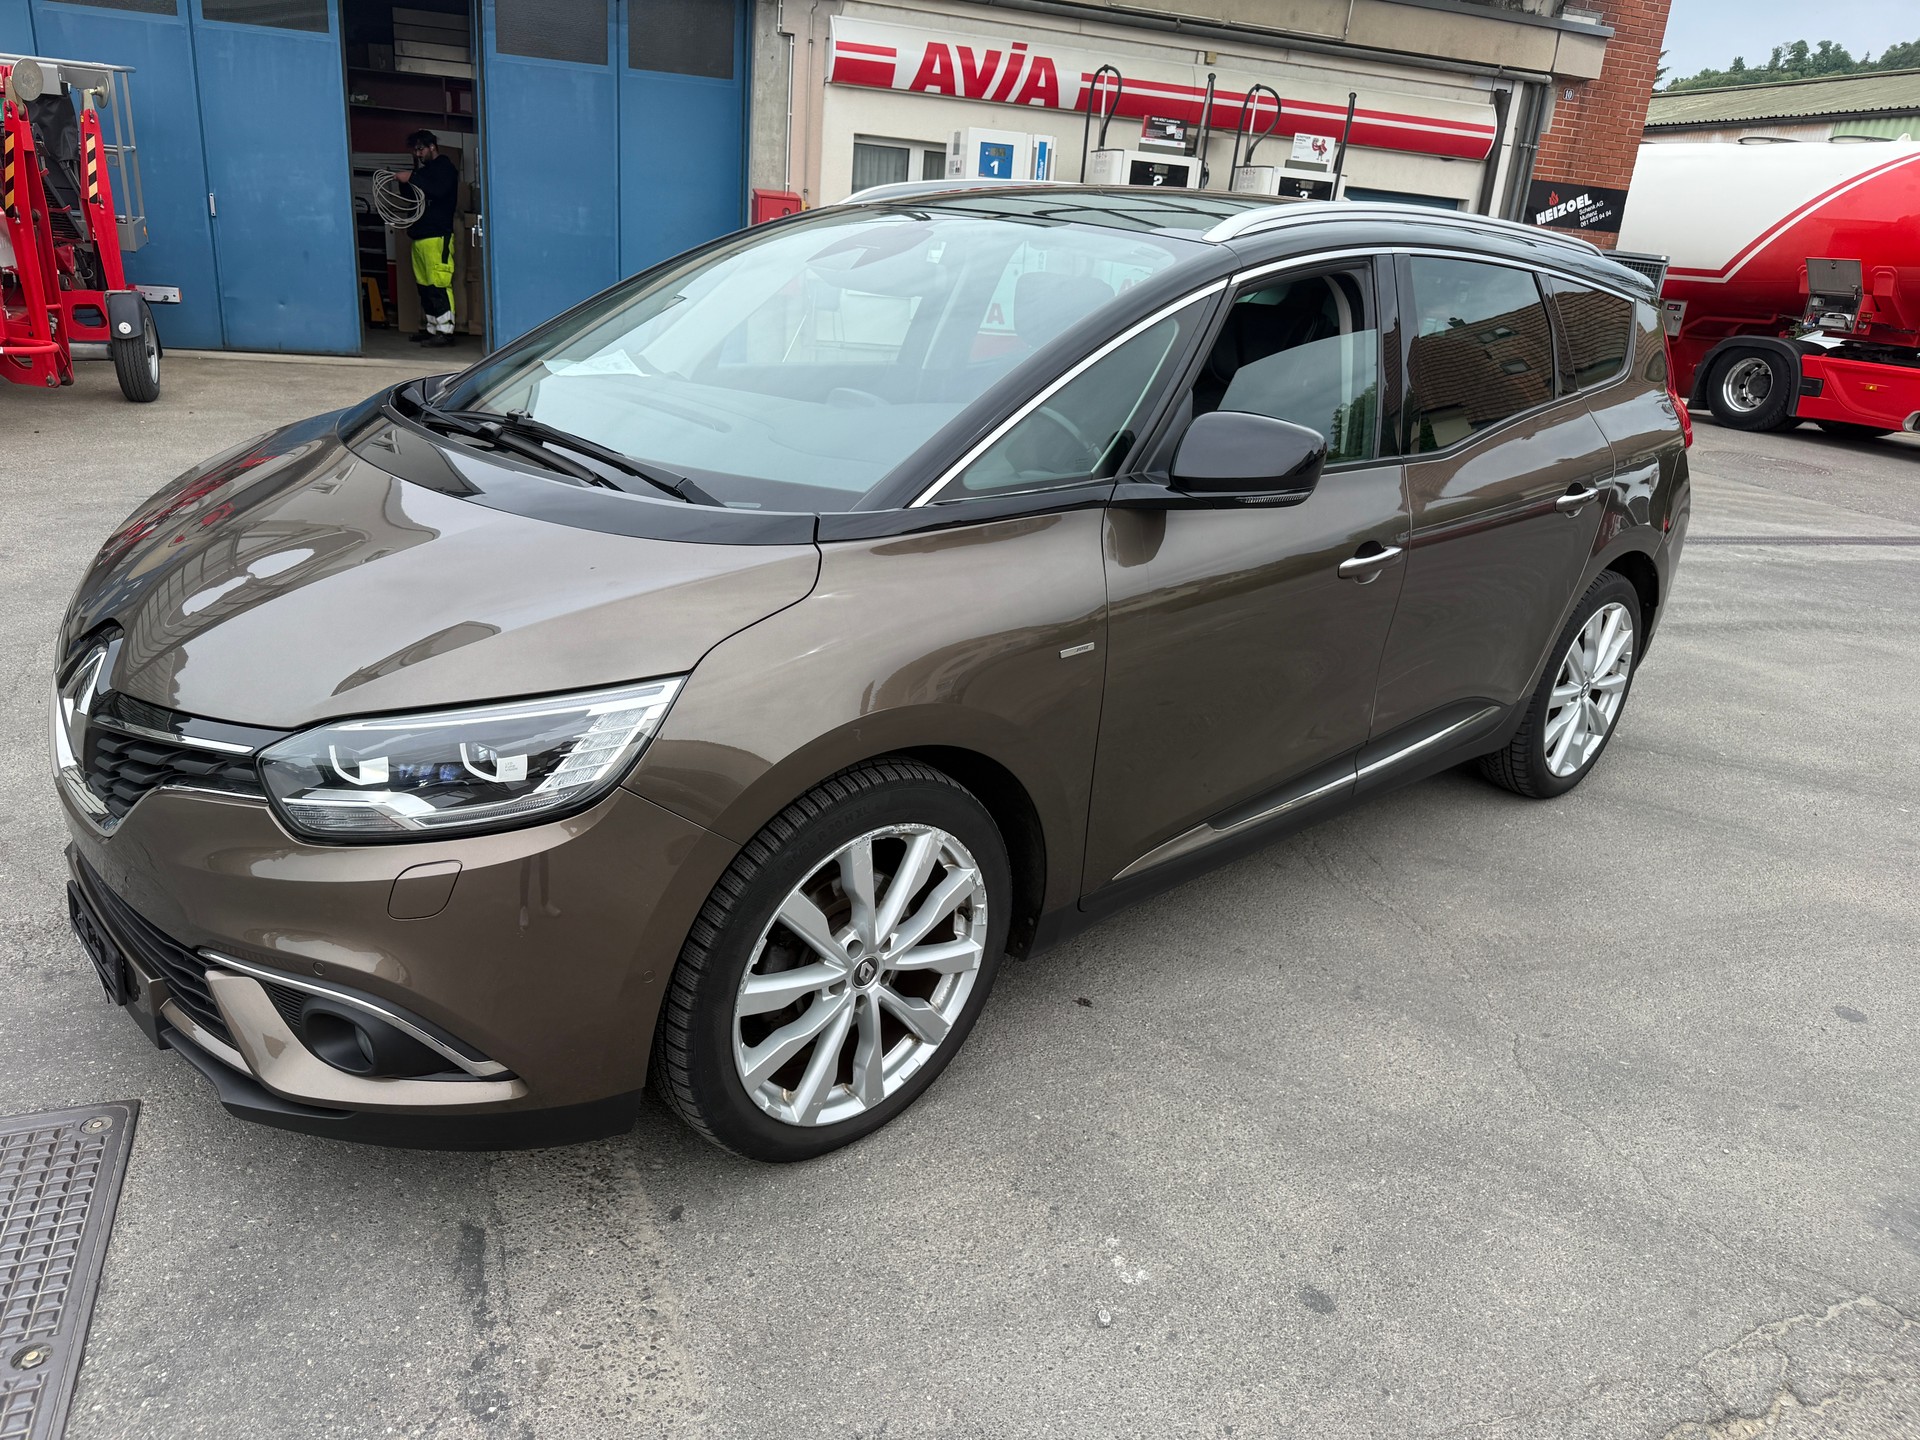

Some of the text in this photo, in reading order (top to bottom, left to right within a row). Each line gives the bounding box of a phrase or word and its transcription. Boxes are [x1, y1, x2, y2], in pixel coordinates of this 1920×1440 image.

[909, 41, 1060, 108] AVIA
[1564, 90, 1573, 99] 10
[990, 160, 999, 175] 1
[1153, 175, 1163, 186] 2
[1536, 193, 1593, 225] HEIZOEL
[1578, 200, 1604, 215] Schenk AG
[1579, 210, 1598, 221] Muttenz
[1580, 220, 1589, 228] 061
[1606, 210, 1612, 218] 94
